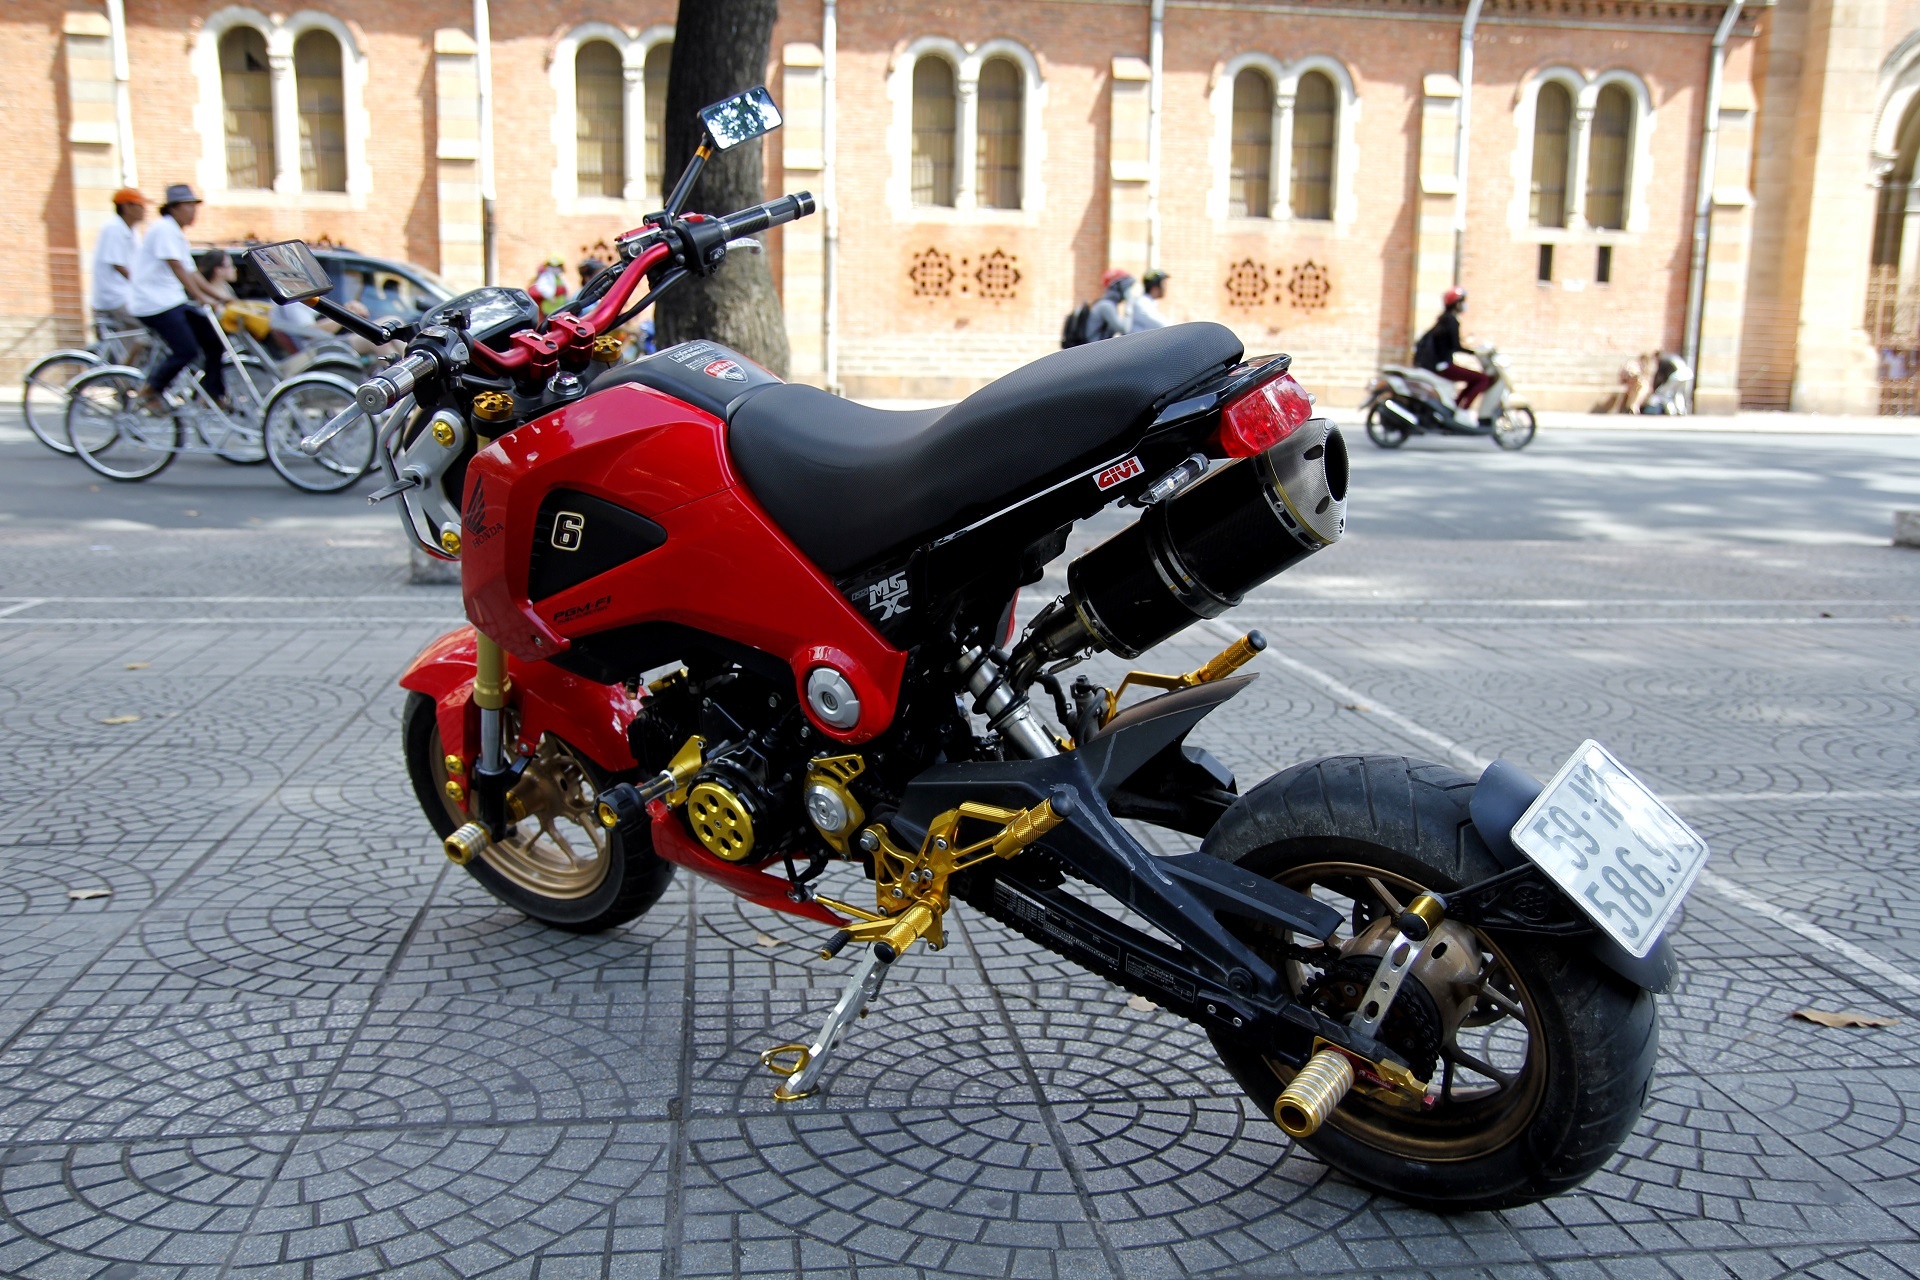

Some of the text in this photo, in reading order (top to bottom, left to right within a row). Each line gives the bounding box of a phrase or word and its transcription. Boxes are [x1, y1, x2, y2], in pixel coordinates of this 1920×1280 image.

[1097, 459, 1140, 488] GIVI
[472, 522, 505, 549] HONDA
[551, 510, 585, 551] 6
